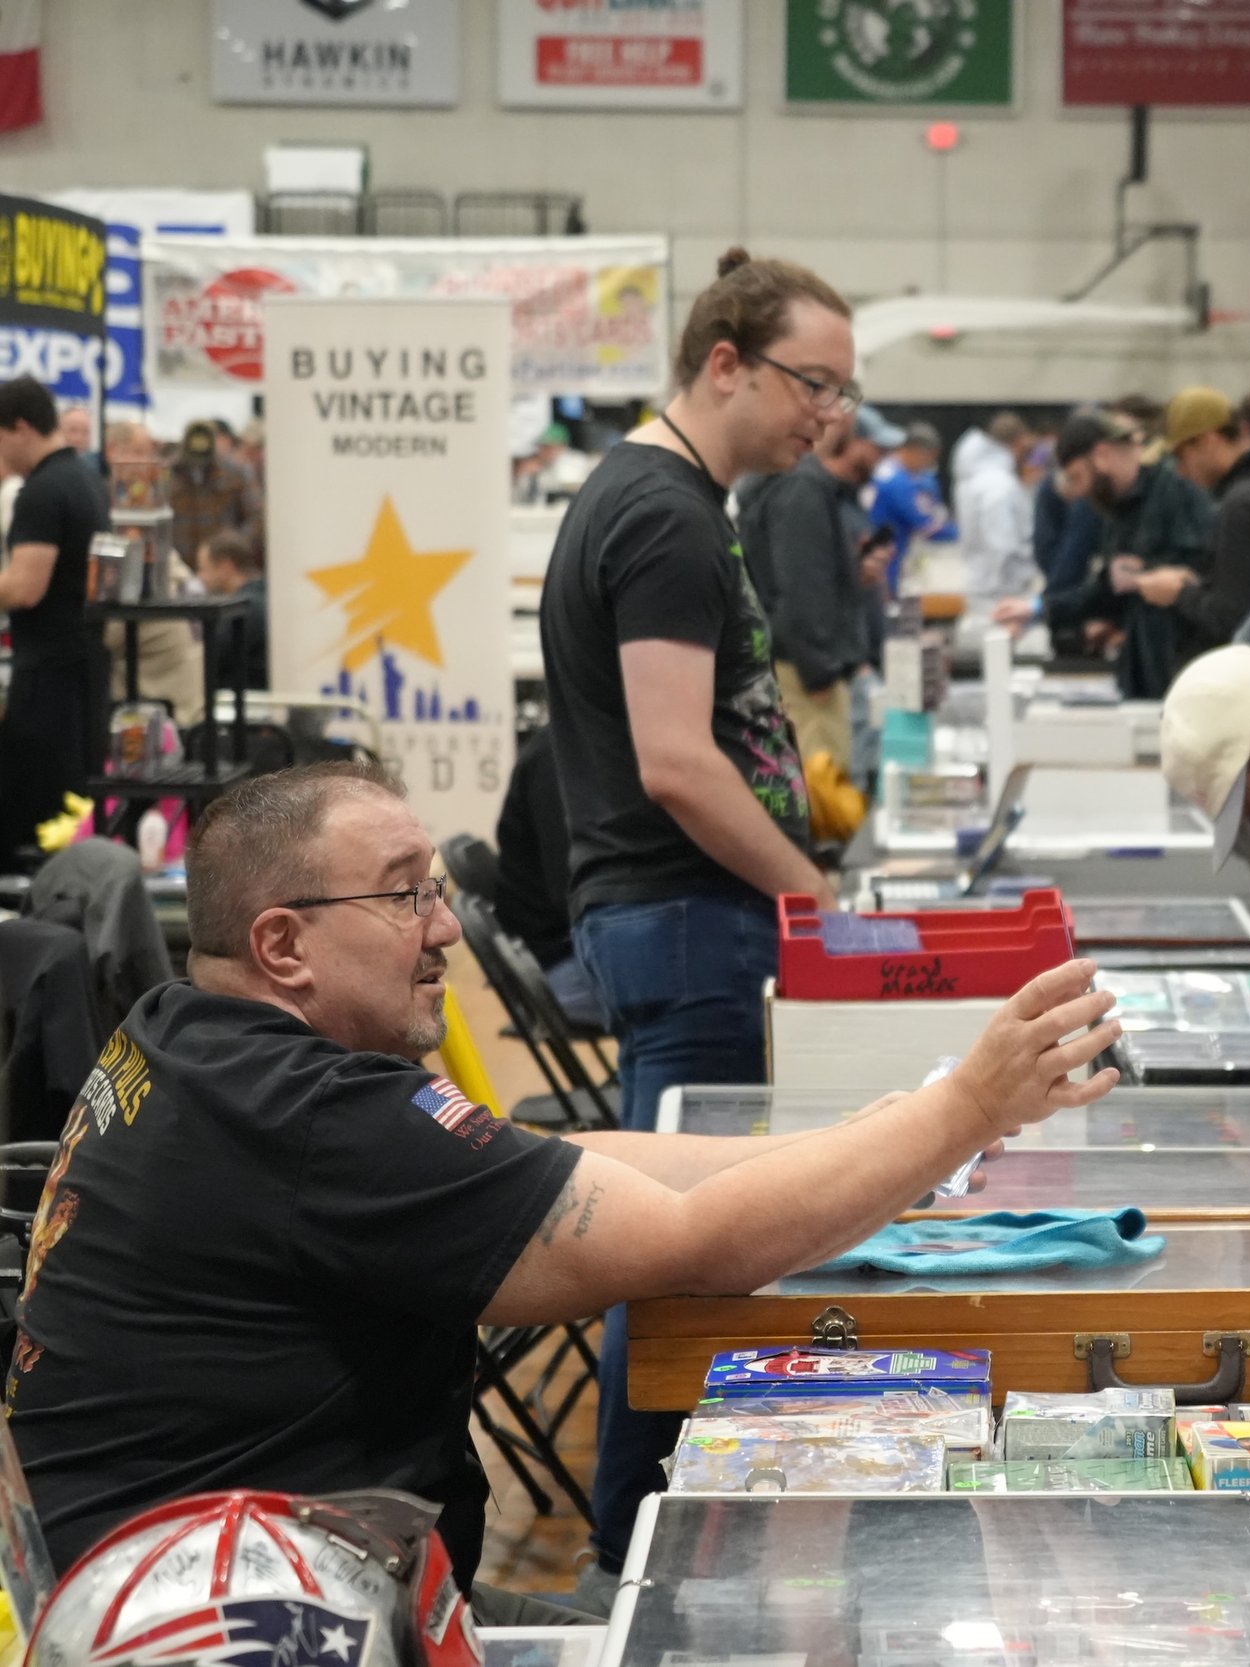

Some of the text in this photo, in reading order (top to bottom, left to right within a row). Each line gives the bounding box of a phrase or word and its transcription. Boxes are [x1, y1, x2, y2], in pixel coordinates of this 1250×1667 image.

[261, 39, 412, 70] HAWKIN
[290, 346, 487, 381] BUYING
[312, 389, 477, 423] VINTAGE
[330, 434, 448, 457] MODERN
[111, 1040, 152, 1127] PULLS
